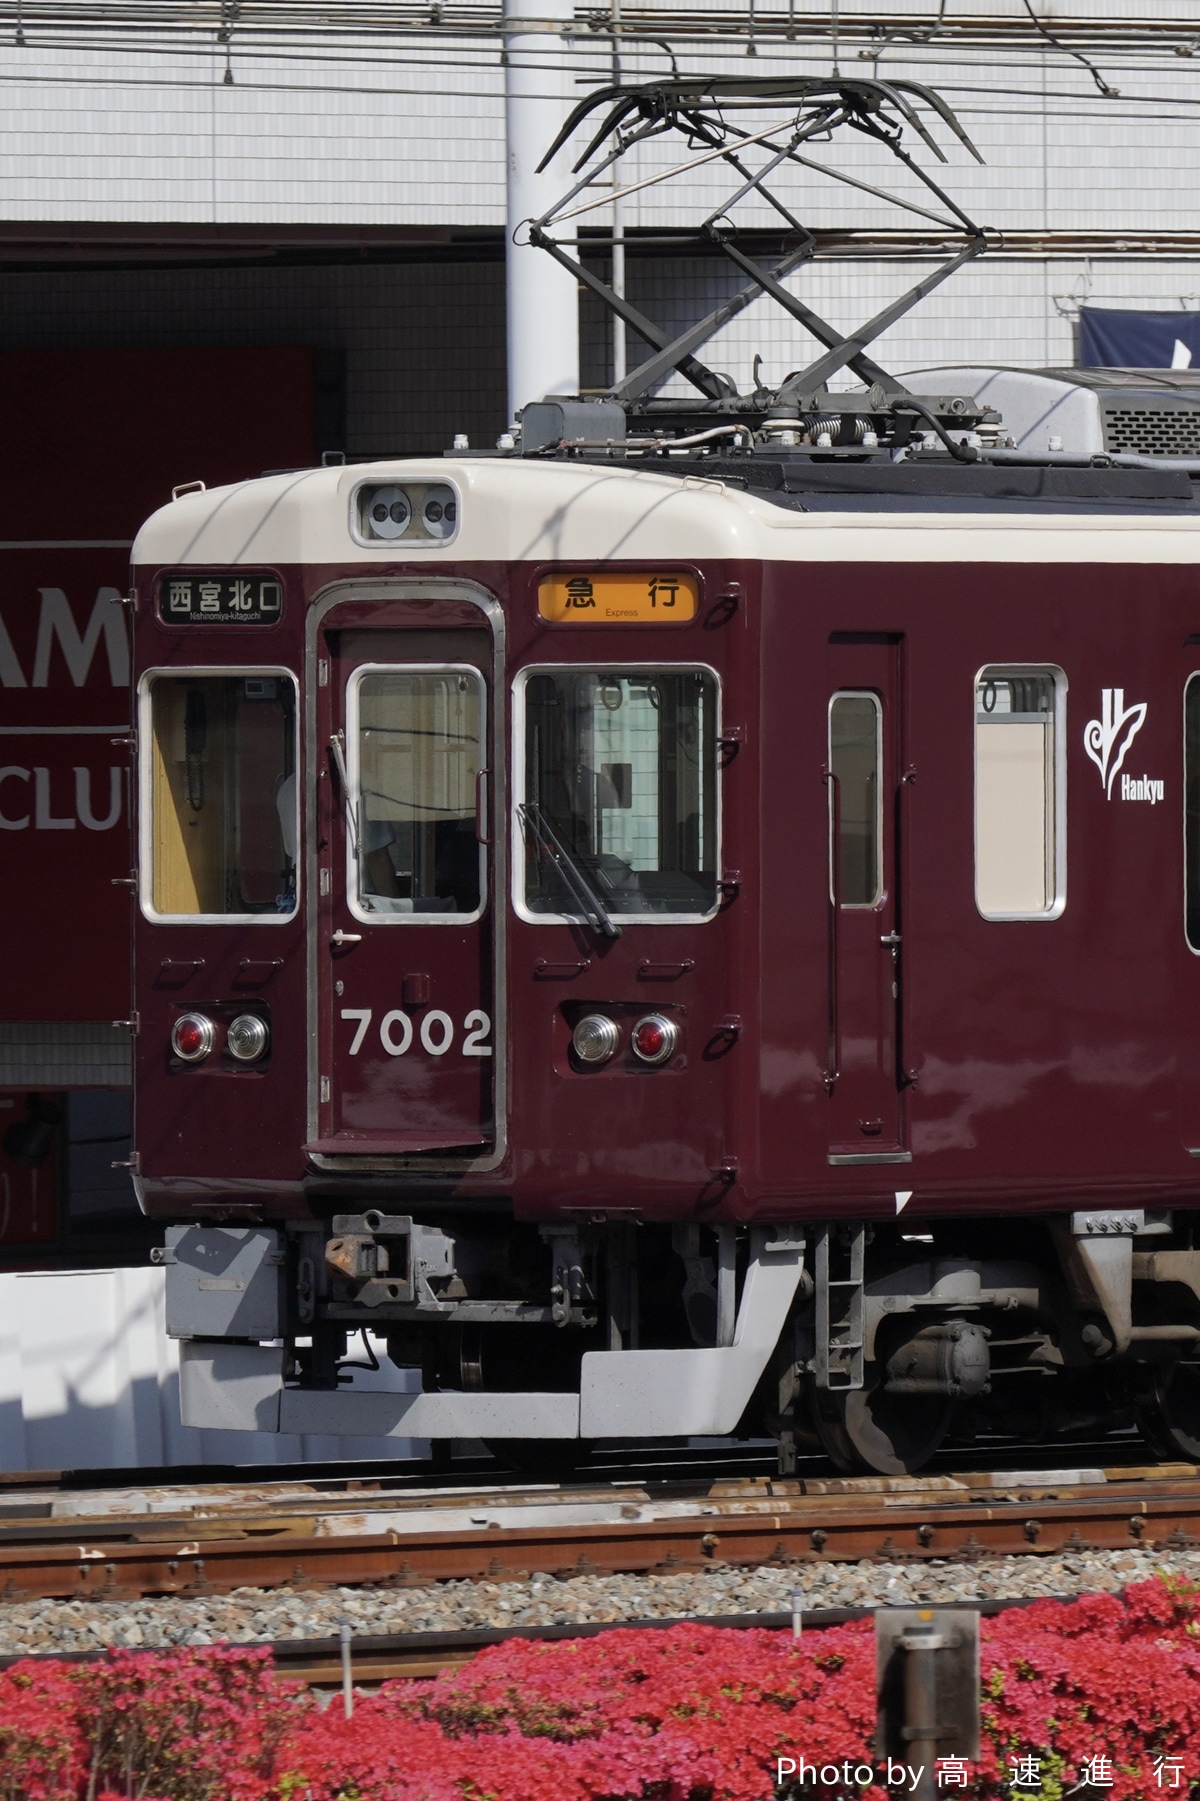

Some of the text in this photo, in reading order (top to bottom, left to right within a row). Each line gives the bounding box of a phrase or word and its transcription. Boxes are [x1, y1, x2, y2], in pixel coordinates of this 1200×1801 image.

[169, 580, 281, 612] 西宮北口
[189, 611, 262, 622] Nishinomiya-kitaguchi
[605, 608, 639, 618] Express
[1121, 773, 1165, 805] Hankyu
[340, 1008, 493, 1057] 7002
